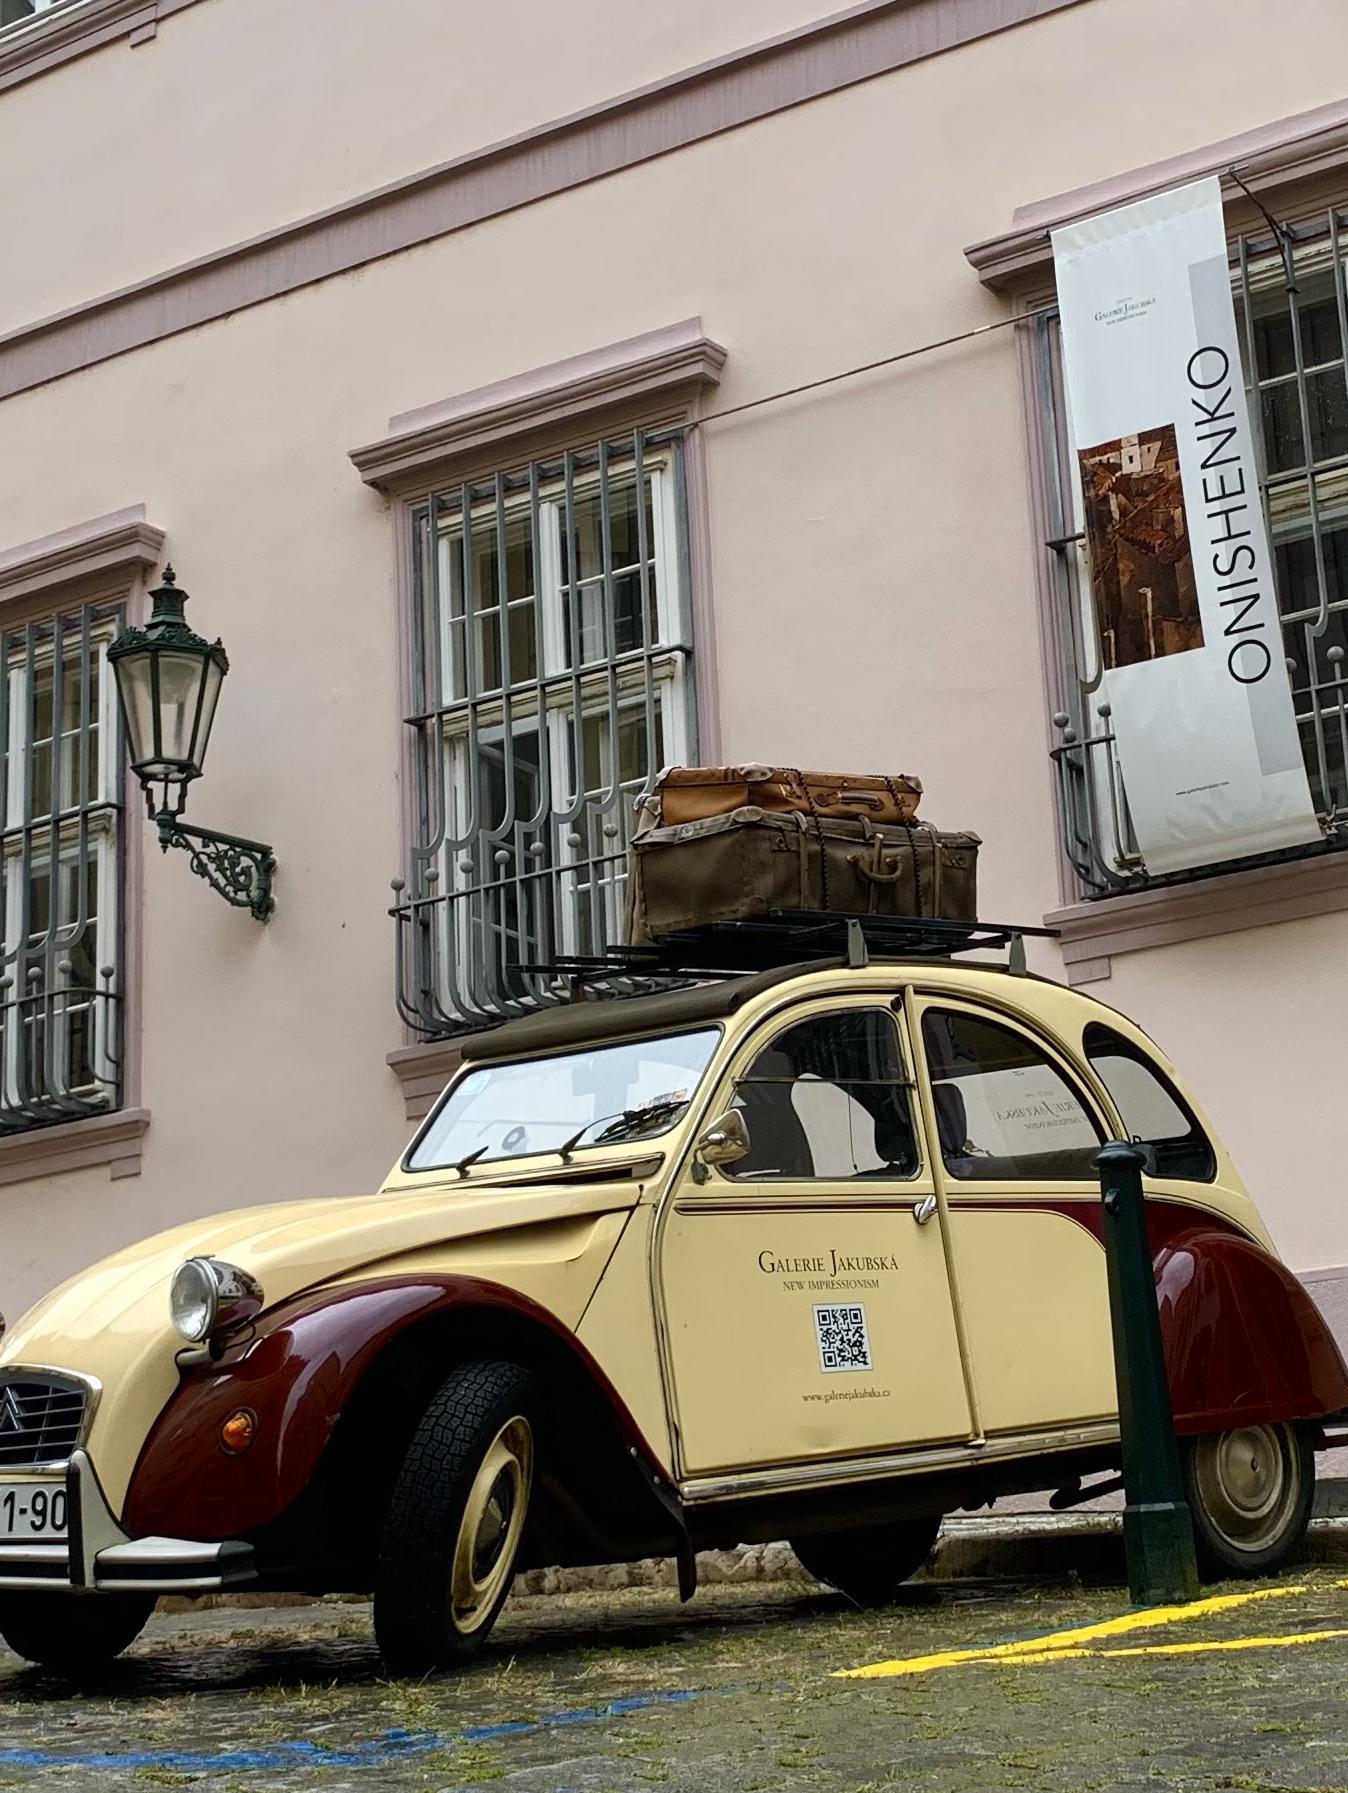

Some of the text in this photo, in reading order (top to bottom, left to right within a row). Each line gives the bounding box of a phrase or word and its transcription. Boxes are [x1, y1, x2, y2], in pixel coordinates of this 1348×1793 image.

[1186, 345, 1271, 685] ONISHENKO
[758, 1249, 899, 1277] GALERIE JAKUBSKÁ
[782, 1279, 880, 1291] NEW IMPRESSIONISM
